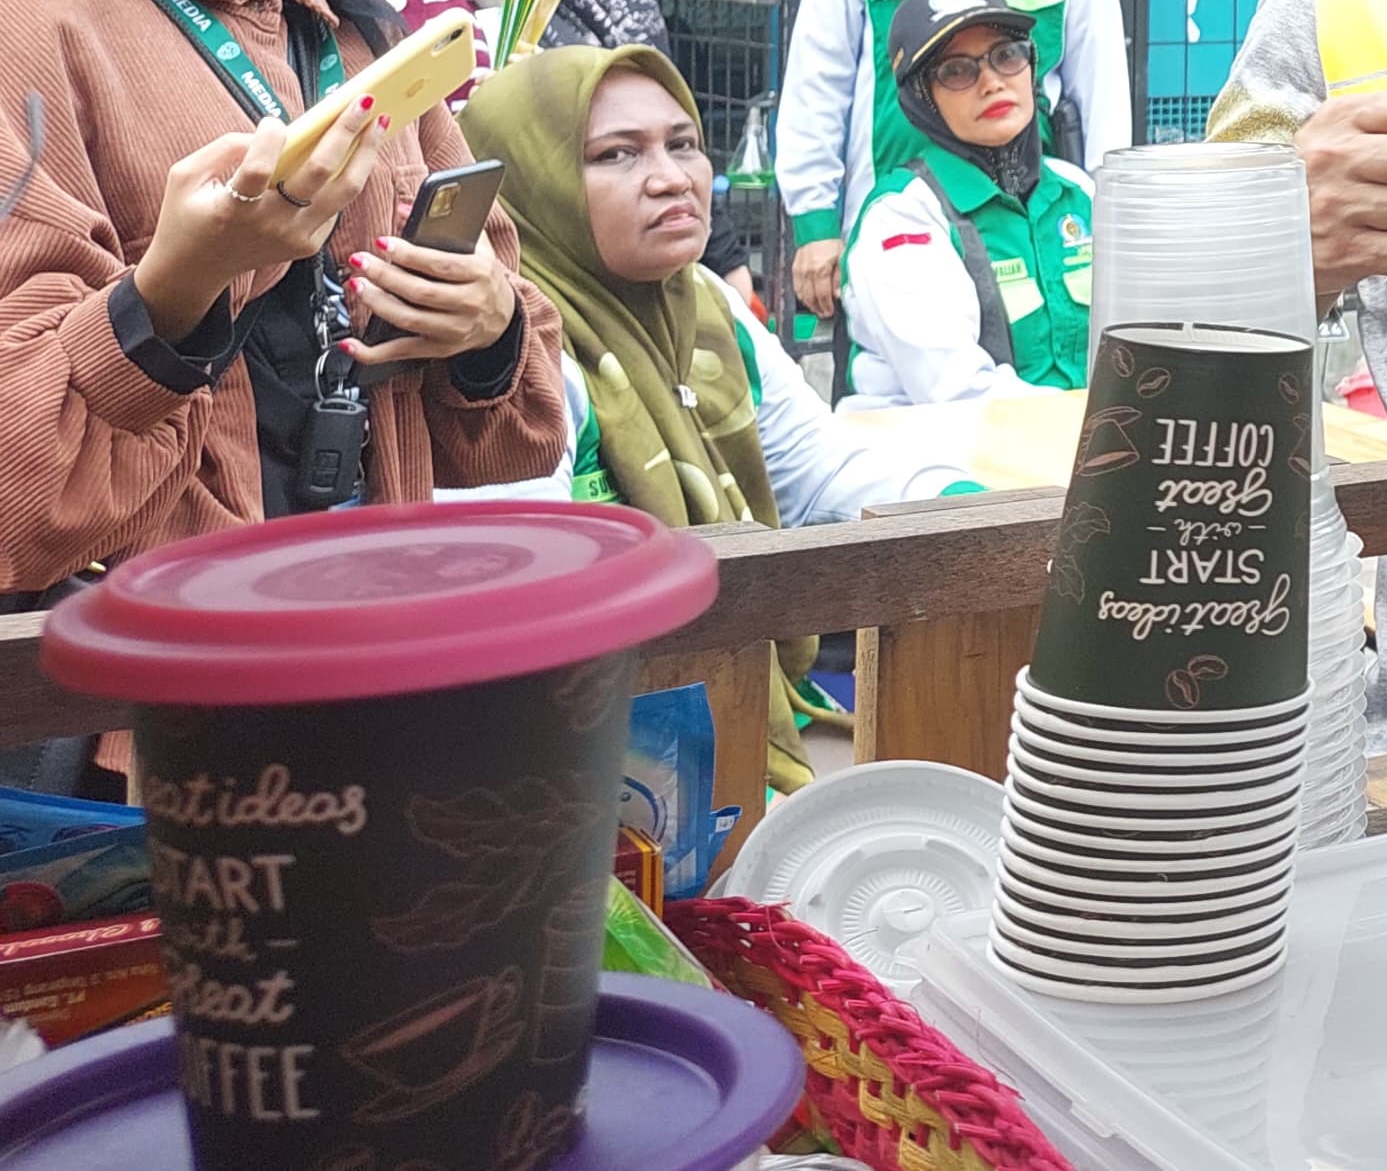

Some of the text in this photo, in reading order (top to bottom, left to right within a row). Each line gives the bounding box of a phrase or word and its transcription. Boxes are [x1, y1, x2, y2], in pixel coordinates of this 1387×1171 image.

[240, 71, 283, 119] MEDIA
[1151, 417, 1275, 468] COFFEE
[1139, 548, 1266, 585] START
[1098, 589, 1182, 641] ideas
[222, 763, 367, 835] ideas
[155, 845, 297, 914] TART
[184, 1035, 322, 1121] FFEE
